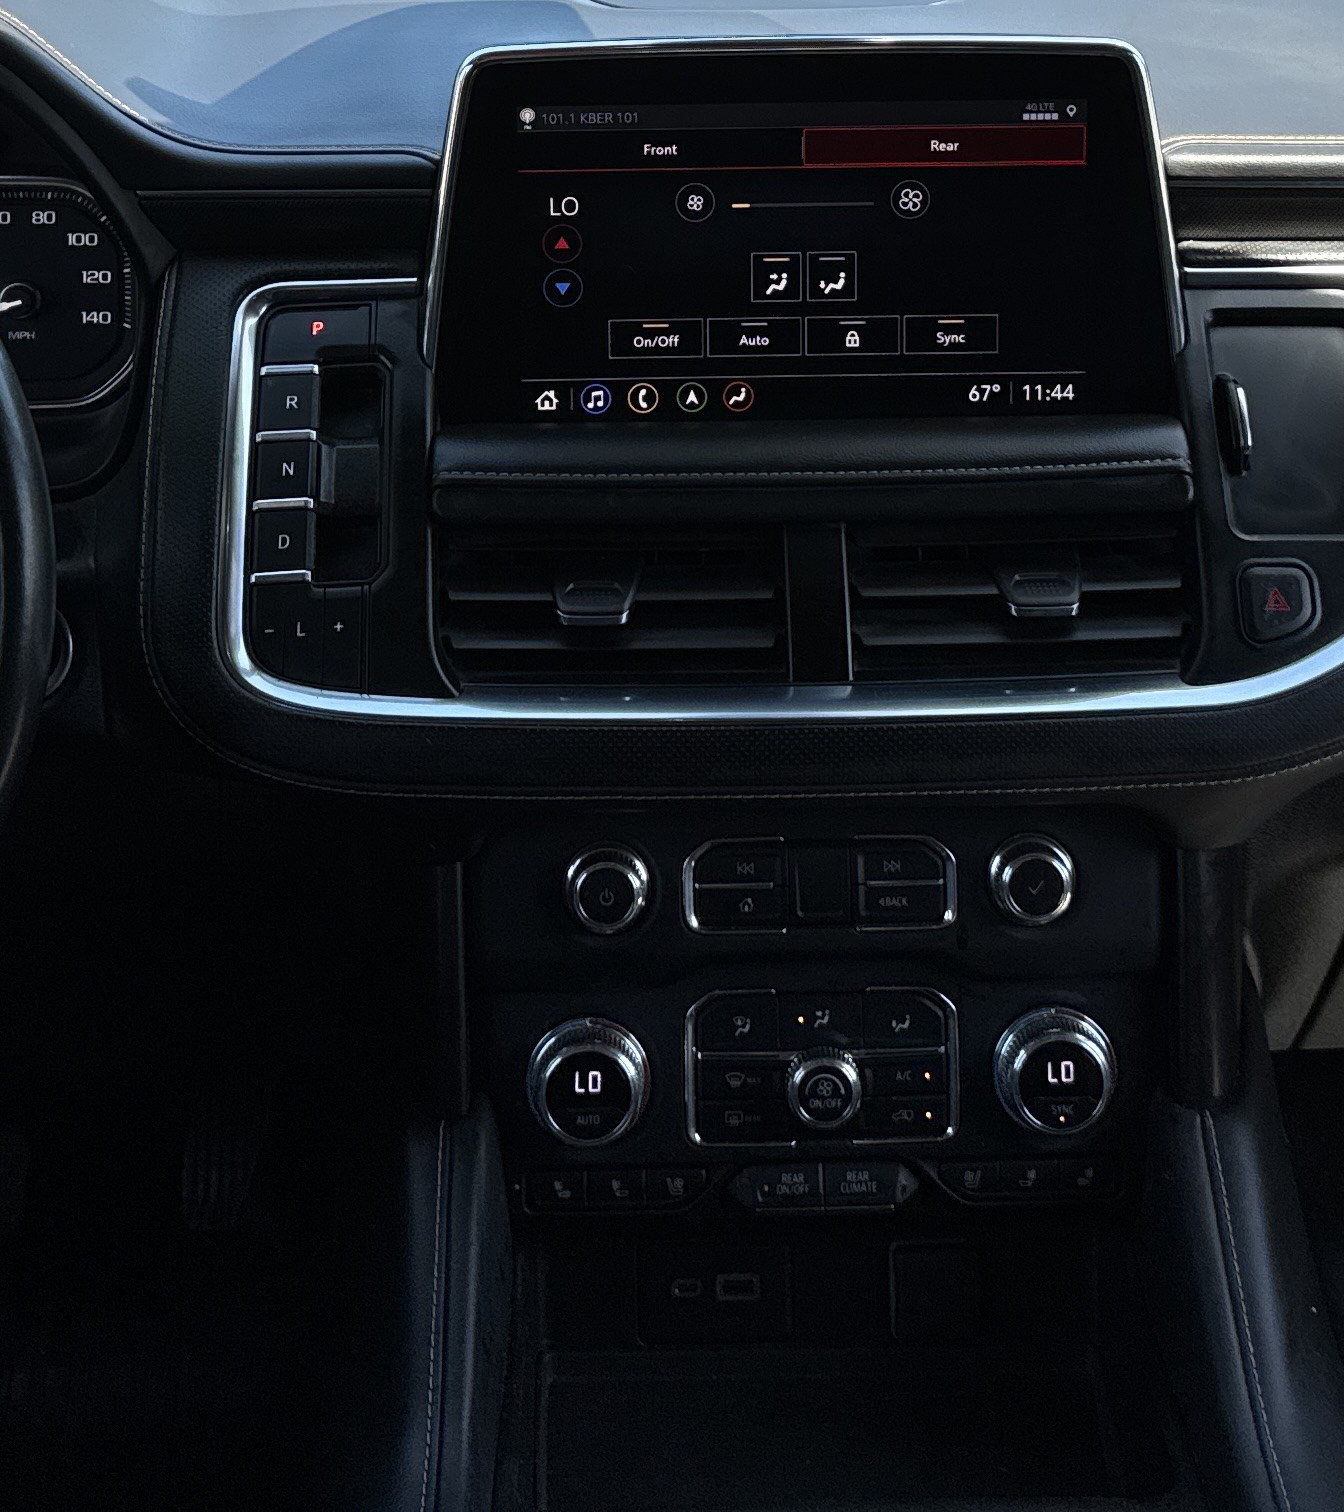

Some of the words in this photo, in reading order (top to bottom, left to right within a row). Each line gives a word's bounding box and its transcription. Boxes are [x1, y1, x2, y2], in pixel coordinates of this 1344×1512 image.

[542, 113, 576, 125] 101.1
[580, 113, 614, 125] KBER
[617, 112, 639, 123] 101
[643, 144, 678, 156] Front
[930, 140, 960, 152] Rear
[549, 196, 579, 217] LO
[32, 211, 56, 225] 80
[67, 233, 98, 246] 100
[81, 270, 112, 284] 120
[80, 311, 112, 325] 140
[312, 320, 325, 335] P
[8, 331, 36, 341] MPH
[633, 334, 680, 349] On/Off
[738, 333, 770, 347] Auto
[935, 331, 966, 346] Sync
[968, 383, 1001, 402] 67°
[1022, 383, 1075, 402] 11:44
[286, 395, 299, 409] R
[282, 461, 295, 477] N
[278, 535, 290, 550] D
[296, 622, 306, 638] L
[885, 896, 909, 907] BACK
[896, 1070, 913, 1081] A/C
[1047, 1060, 1075, 1084] LO
[574, 1070, 602, 1094] LO
[809, 1098, 843, 1109] ON/OFF
[781, 1173, 805, 1183] REAR
[847, 1170, 870, 1181] REAR
[776, 1183, 809, 1195] ON/OFF
[840, 1181, 878, 1194] CLIMATE
